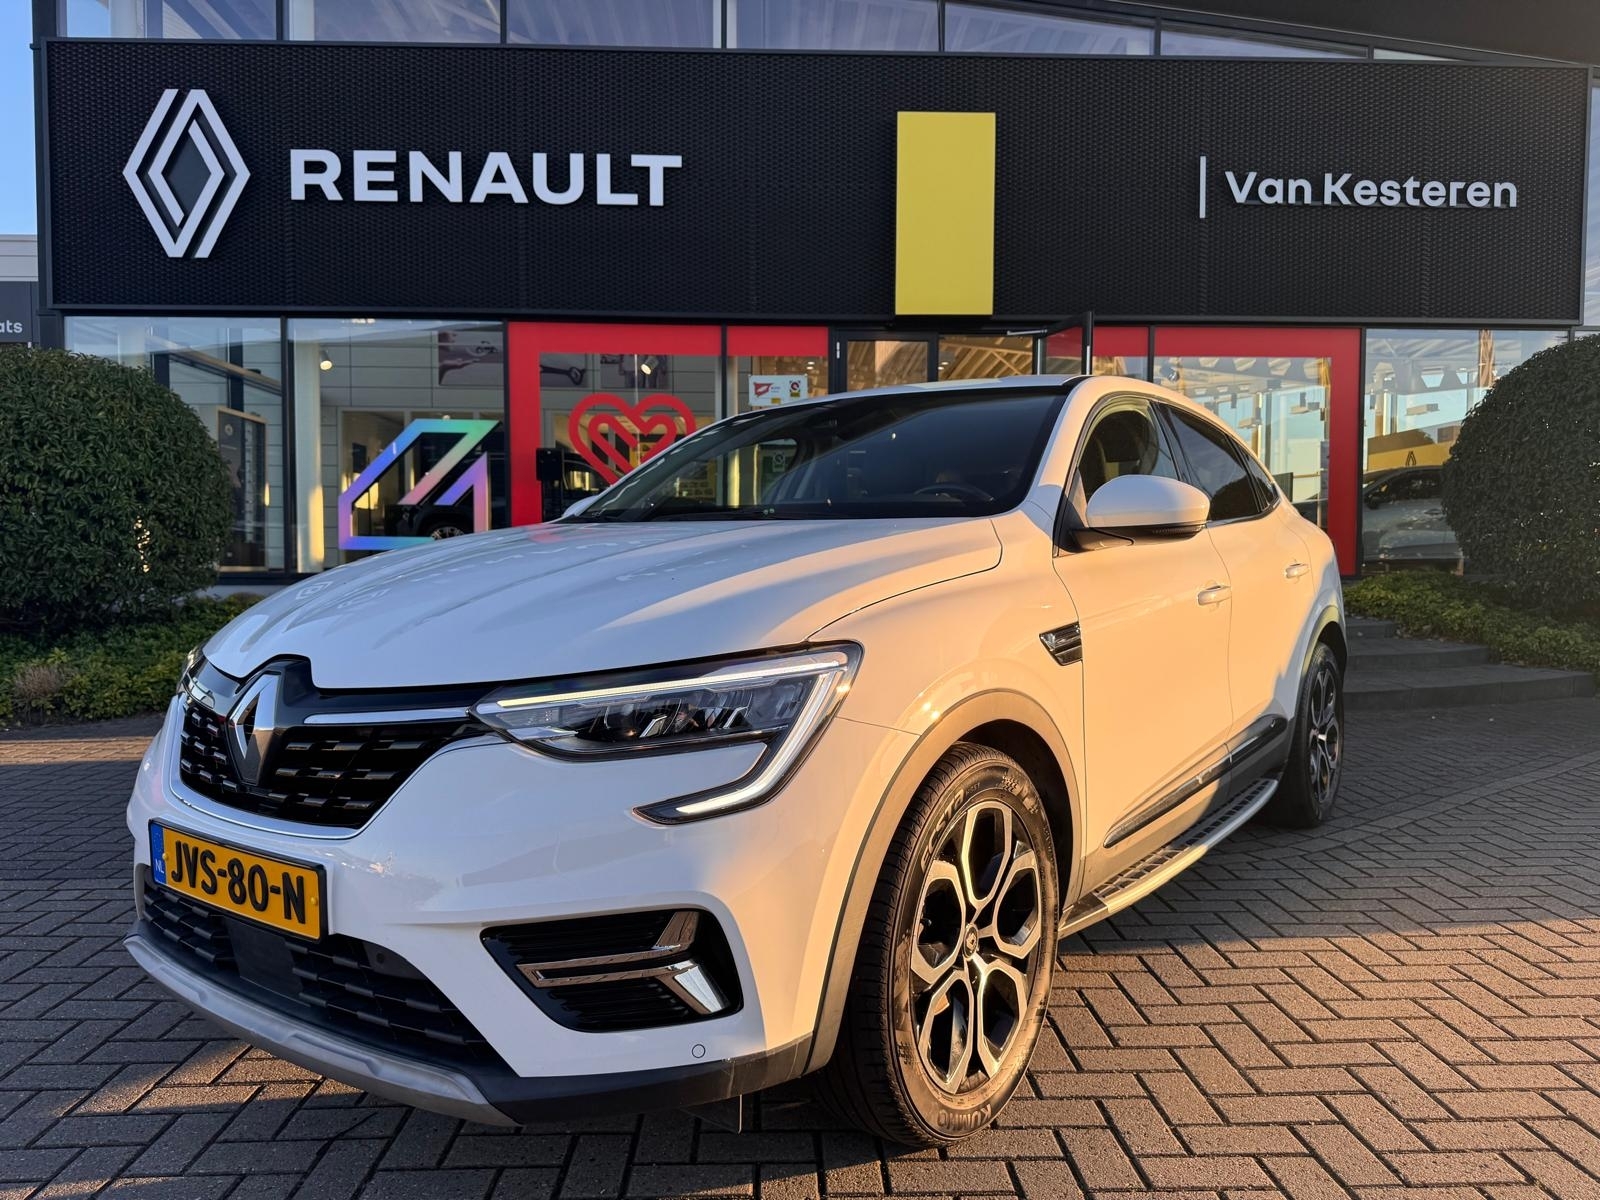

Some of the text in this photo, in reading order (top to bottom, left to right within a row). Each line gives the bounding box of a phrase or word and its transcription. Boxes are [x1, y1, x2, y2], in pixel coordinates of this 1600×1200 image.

[290, 148, 683, 207] RENAULT
[1225, 171, 1517, 208] Van Kesteren
[155, 858, 165, 874] NL
[171, 840, 306, 925] JVS-80-N
